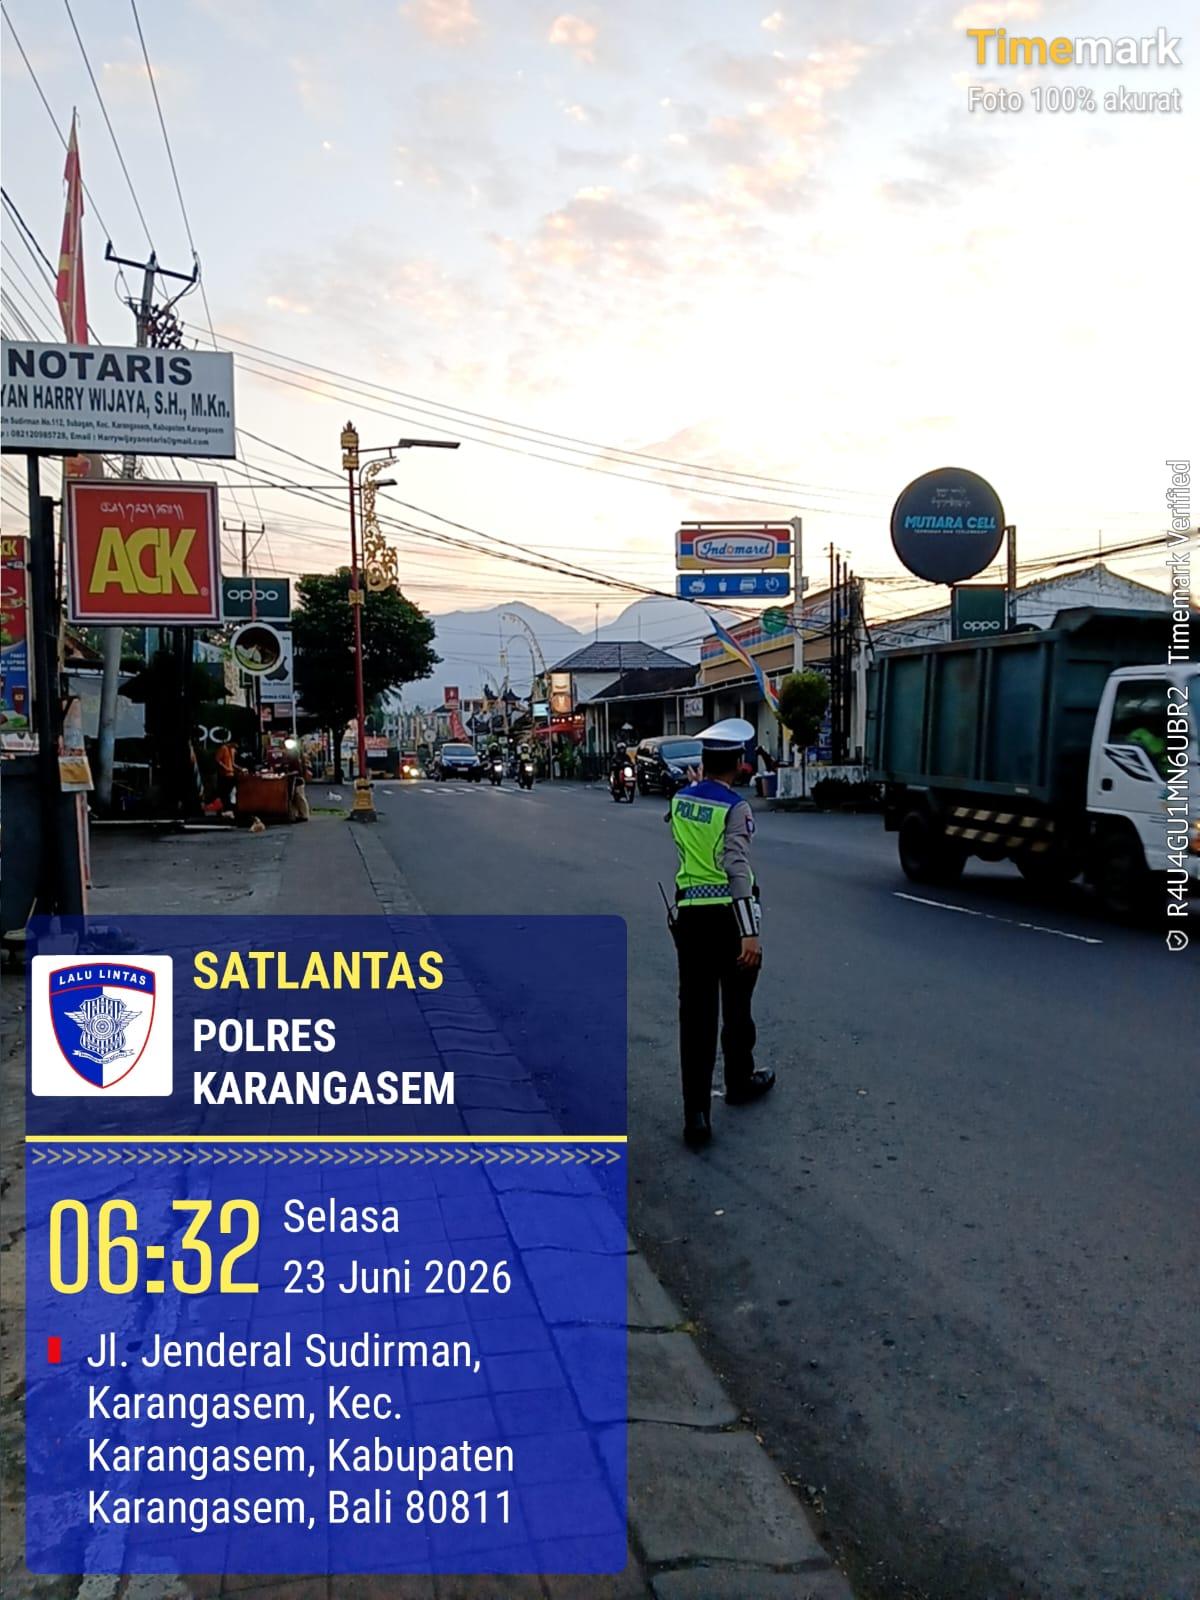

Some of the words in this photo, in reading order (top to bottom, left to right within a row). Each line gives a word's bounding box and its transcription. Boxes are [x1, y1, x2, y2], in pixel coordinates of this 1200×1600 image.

[8, 348, 192, 386] NOTARIS
[33, 385, 84, 411] HARRY
[89, 387, 150, 419] WIJAYA,
[154, 390, 187, 421] S.H.,
[191, 393, 230, 419] M.Kn.
[904, 515, 963, 529] MUTIARA
[966, 516, 996, 529] CELL
[88, 526, 200, 596] ACK
[700, 541, 770, 559] Indomaret
[963, 621, 1000, 632] oppo
[675, 800, 714, 824] POLISI
